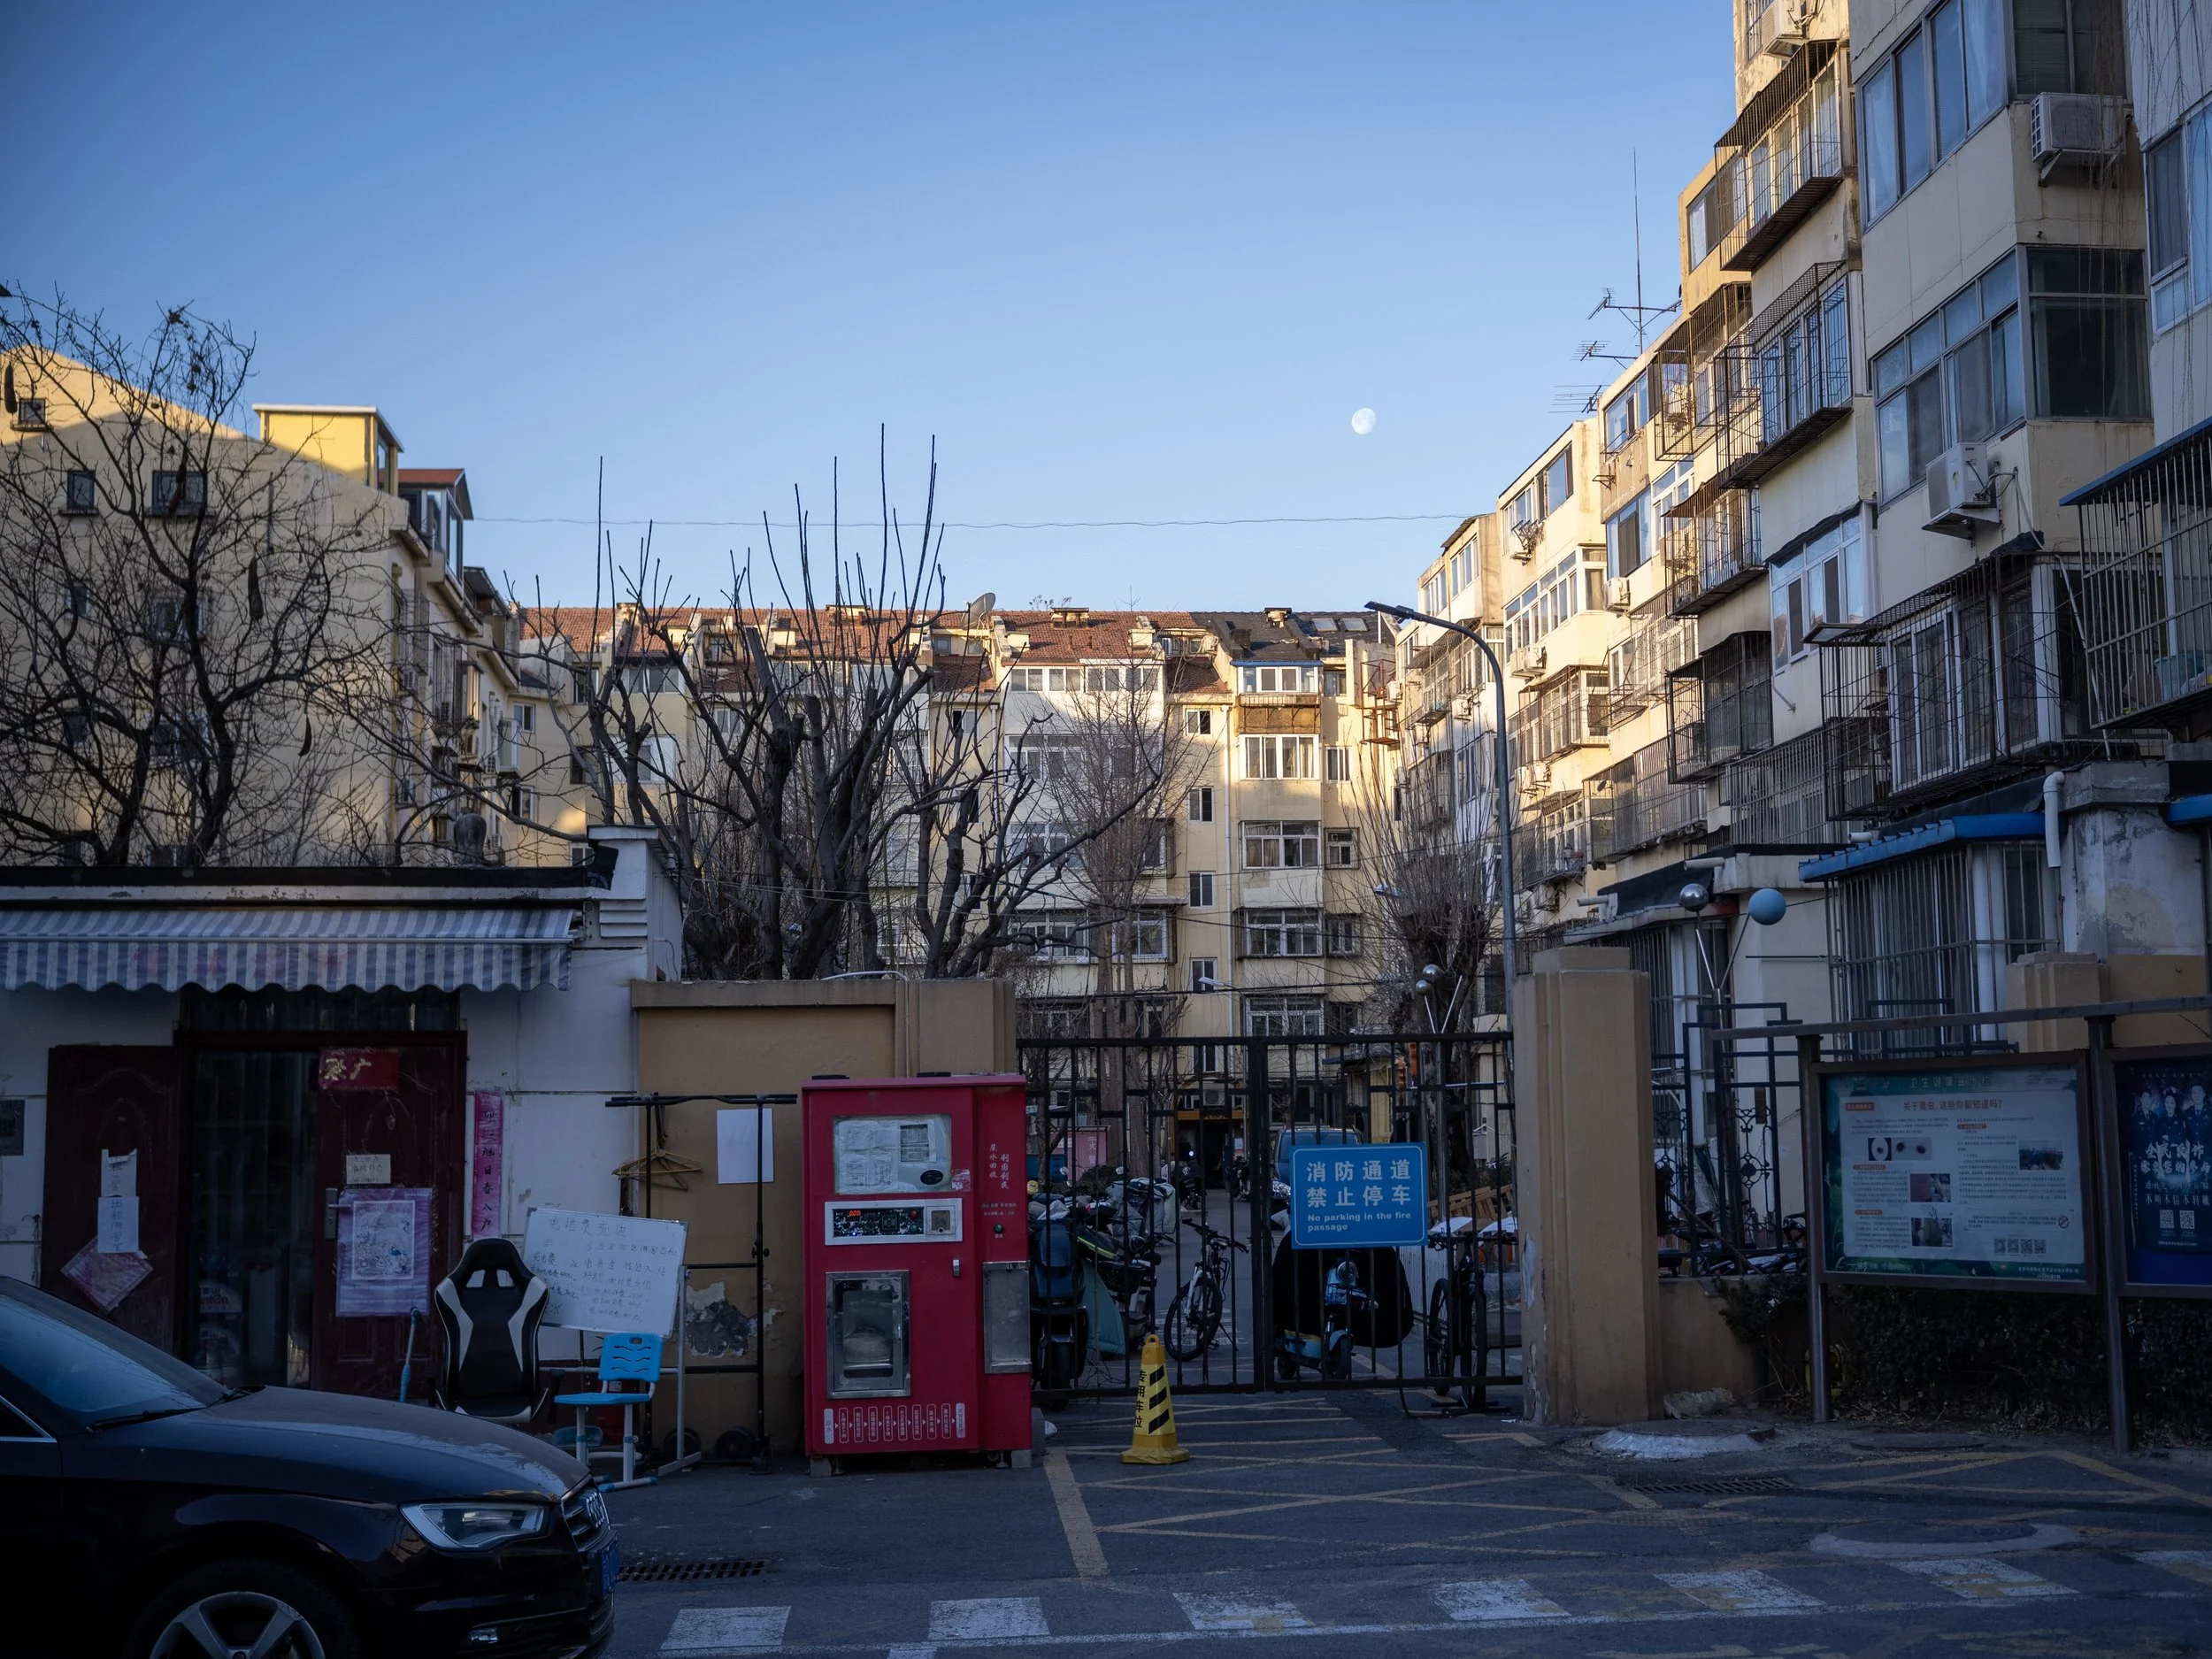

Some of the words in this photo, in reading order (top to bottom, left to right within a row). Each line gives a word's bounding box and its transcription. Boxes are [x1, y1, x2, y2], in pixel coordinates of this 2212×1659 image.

[1306, 1159, 1411, 1182] 消防通道
[1307, 1185, 1411, 1208] 禁止停车
[1308, 1223, 1348, 1233] passage
[1324, 1212, 1361, 1223] parking
[1377, 1211, 1392, 1220] the
[1134, 1370, 1148, 1428] 专用车位
